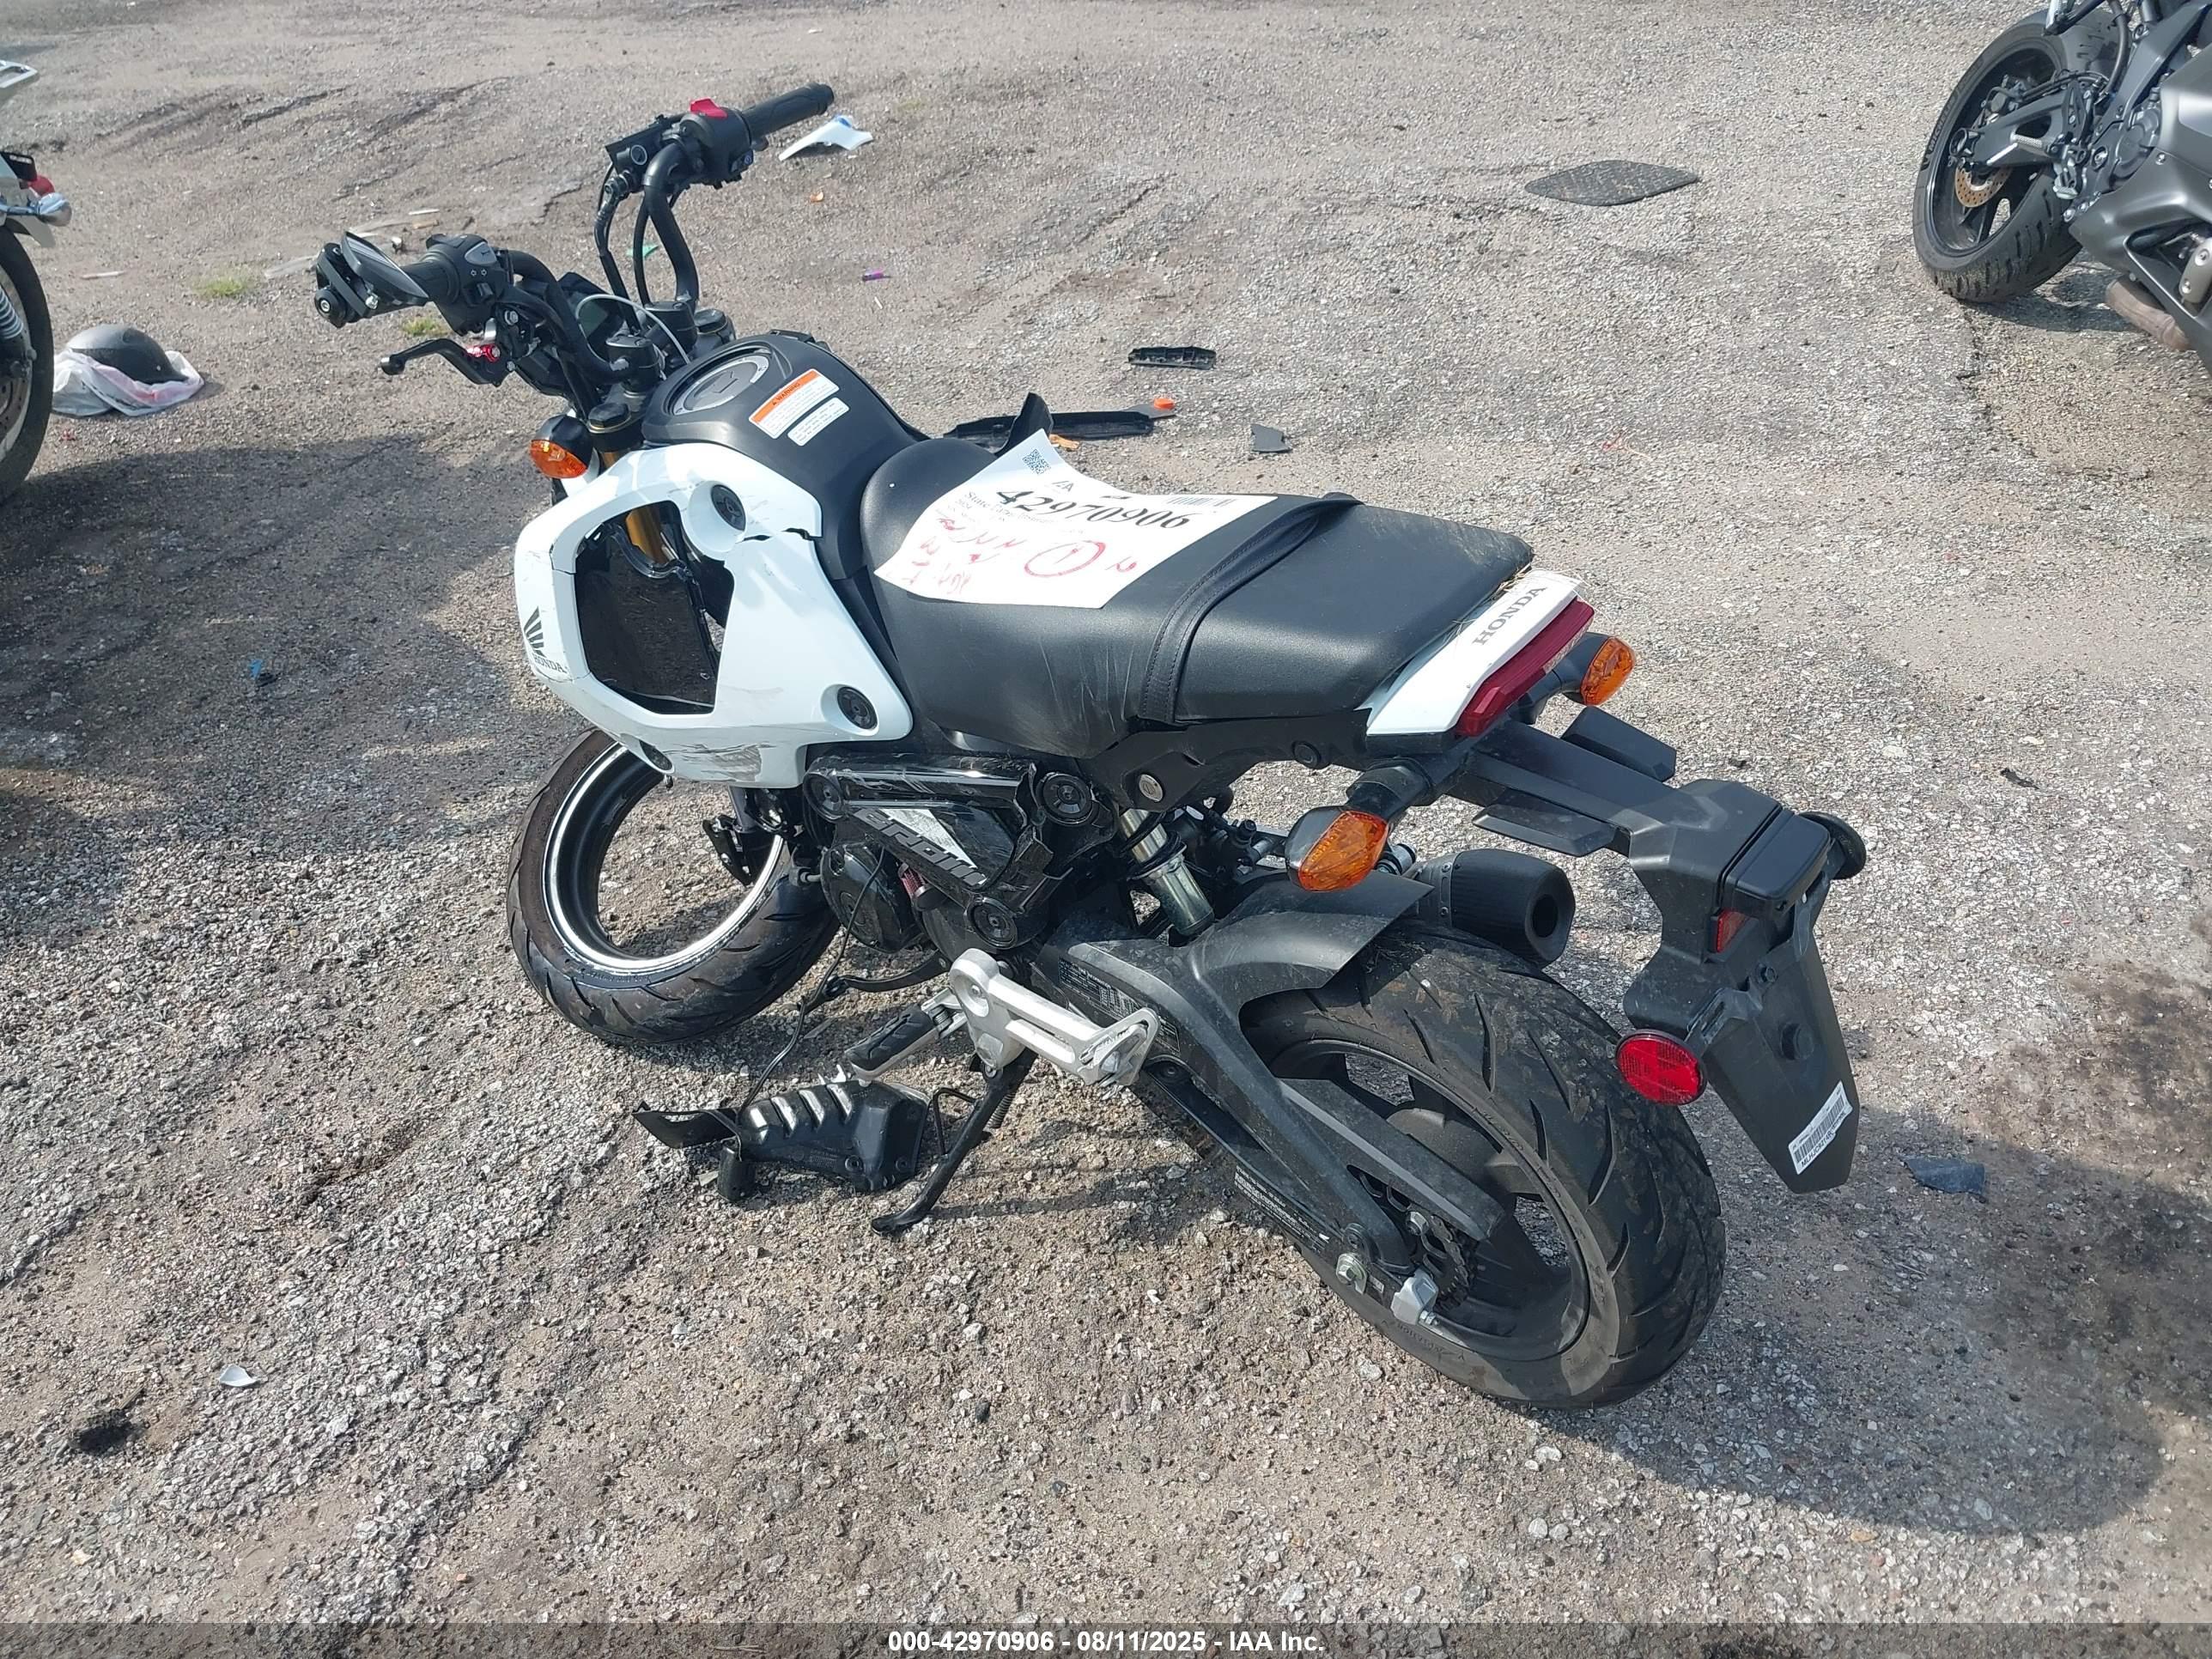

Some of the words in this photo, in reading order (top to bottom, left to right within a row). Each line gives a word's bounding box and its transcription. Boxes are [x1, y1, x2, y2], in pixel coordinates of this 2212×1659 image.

[996, 490, 1199, 529] 42970906
[1472, 586, 1547, 645] HONDA
[534, 654, 568, 674] HONDA
